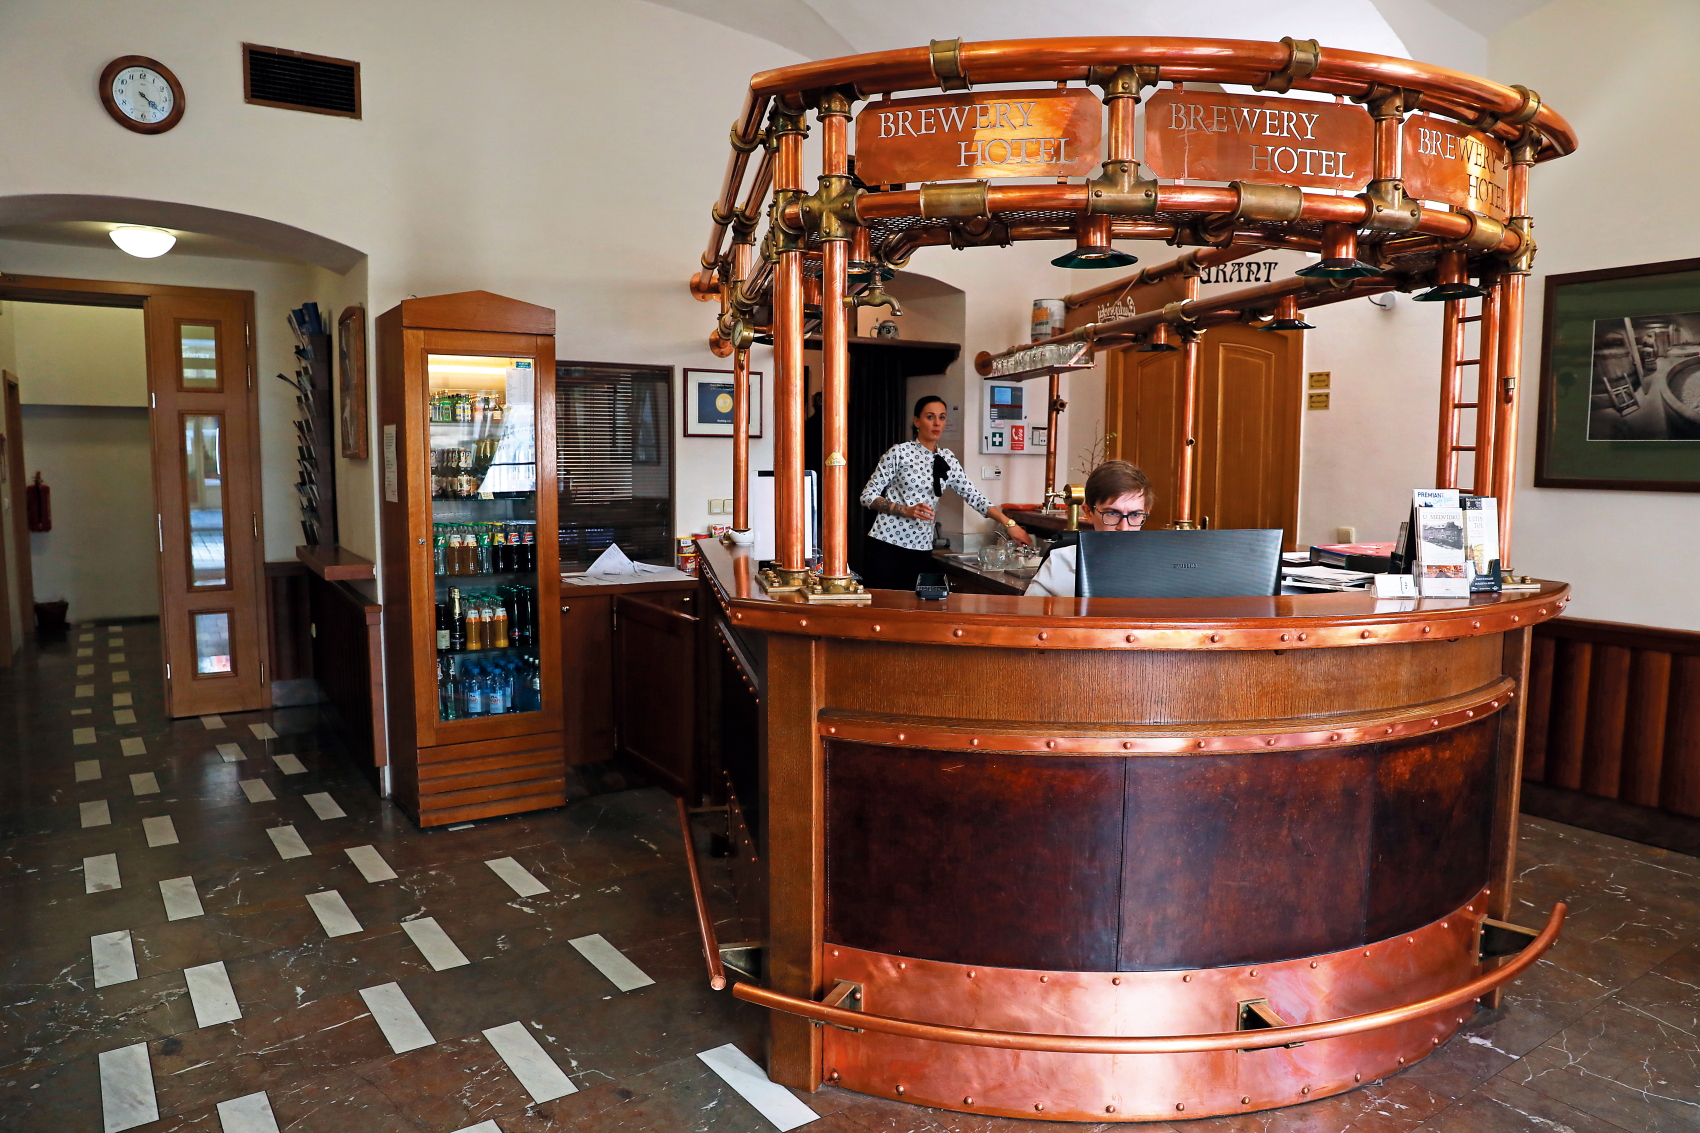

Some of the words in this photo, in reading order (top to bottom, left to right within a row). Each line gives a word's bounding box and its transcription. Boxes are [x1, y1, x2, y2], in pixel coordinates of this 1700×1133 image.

[878, 101, 1036, 138] BREWERY
[1168, 102, 1319, 142] BREWERY
[956, 137, 1079, 168] HOTEL
[1249, 144, 1354, 180] HOTEL
[1417, 128, 1498, 174] BREWERY
[1467, 173, 1506, 212] HOTEL
